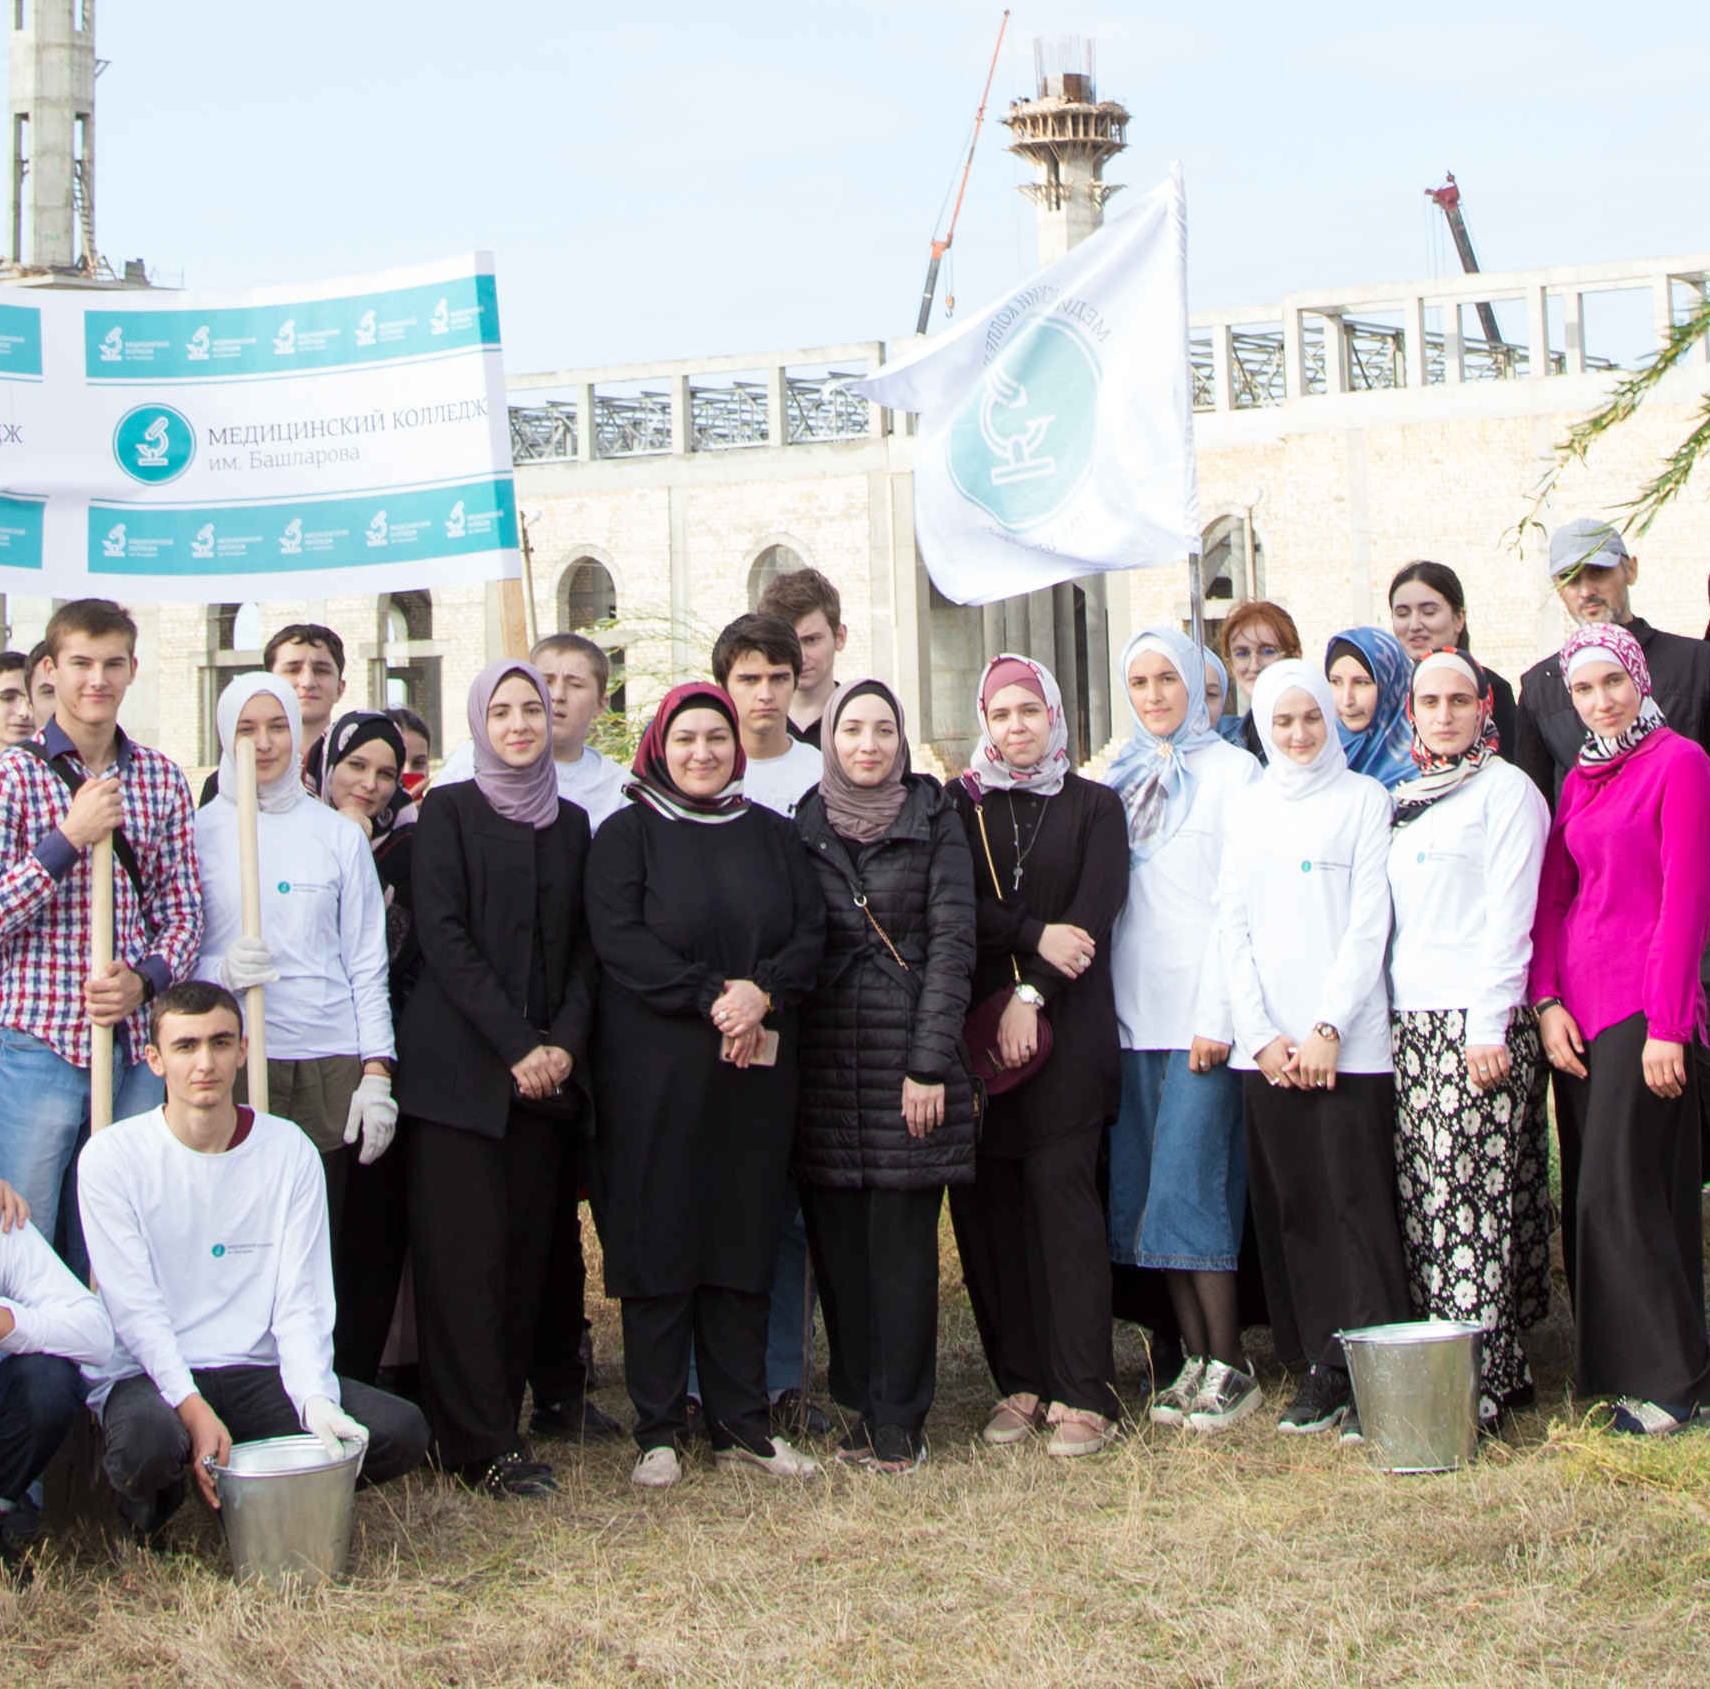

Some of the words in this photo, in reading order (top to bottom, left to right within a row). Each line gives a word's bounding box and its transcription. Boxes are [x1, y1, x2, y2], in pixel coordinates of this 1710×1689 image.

[208, 410, 385, 447] МЕДИЦИНСКИЙ
[393, 397, 490, 430] КОЛЛЕДЖ
[208, 456, 242, 472] им.
[249, 445, 361, 470] Башларова
